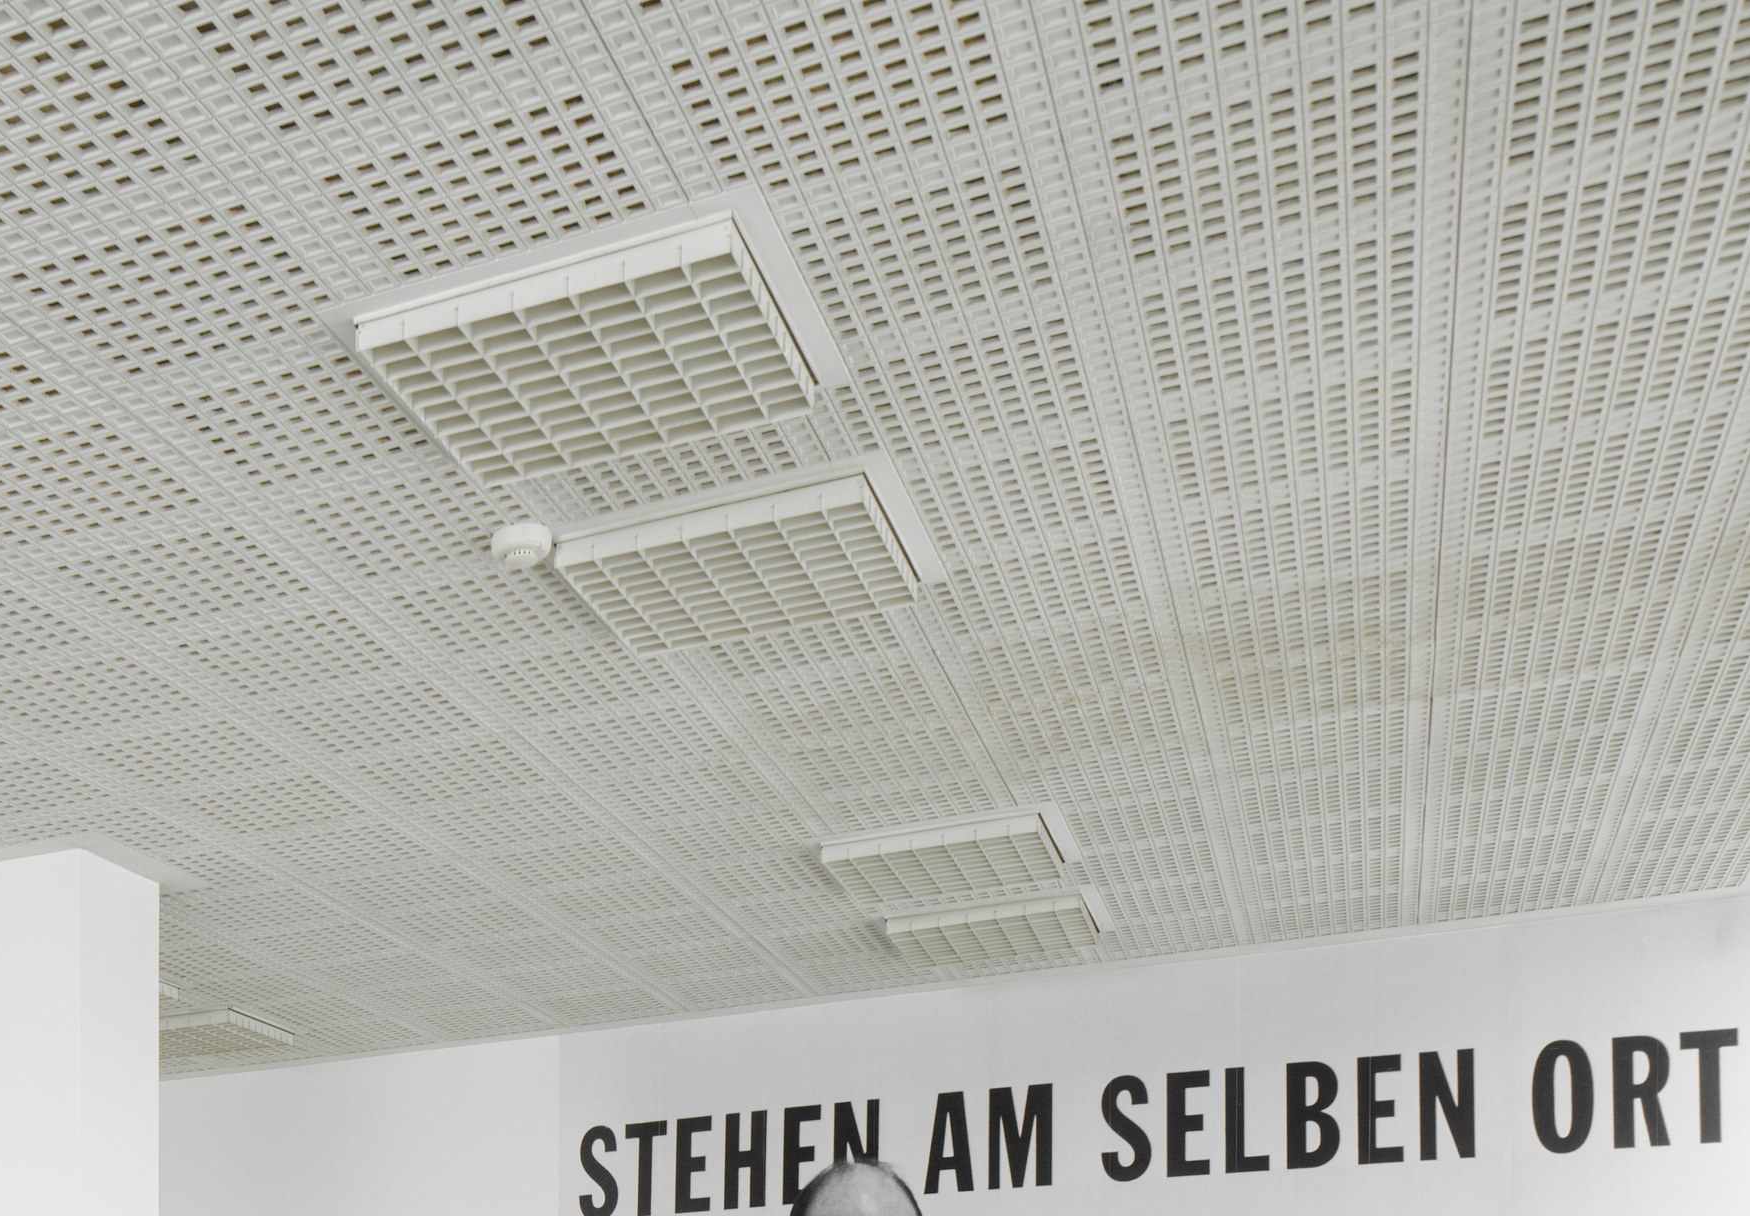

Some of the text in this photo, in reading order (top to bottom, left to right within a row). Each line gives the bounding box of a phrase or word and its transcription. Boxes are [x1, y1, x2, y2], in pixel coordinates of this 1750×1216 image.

[924, 1083, 1053, 1194] AM
[1101, 1048, 1476, 1182] SELBEN
[1531, 1028, 1739, 1154] ORT
